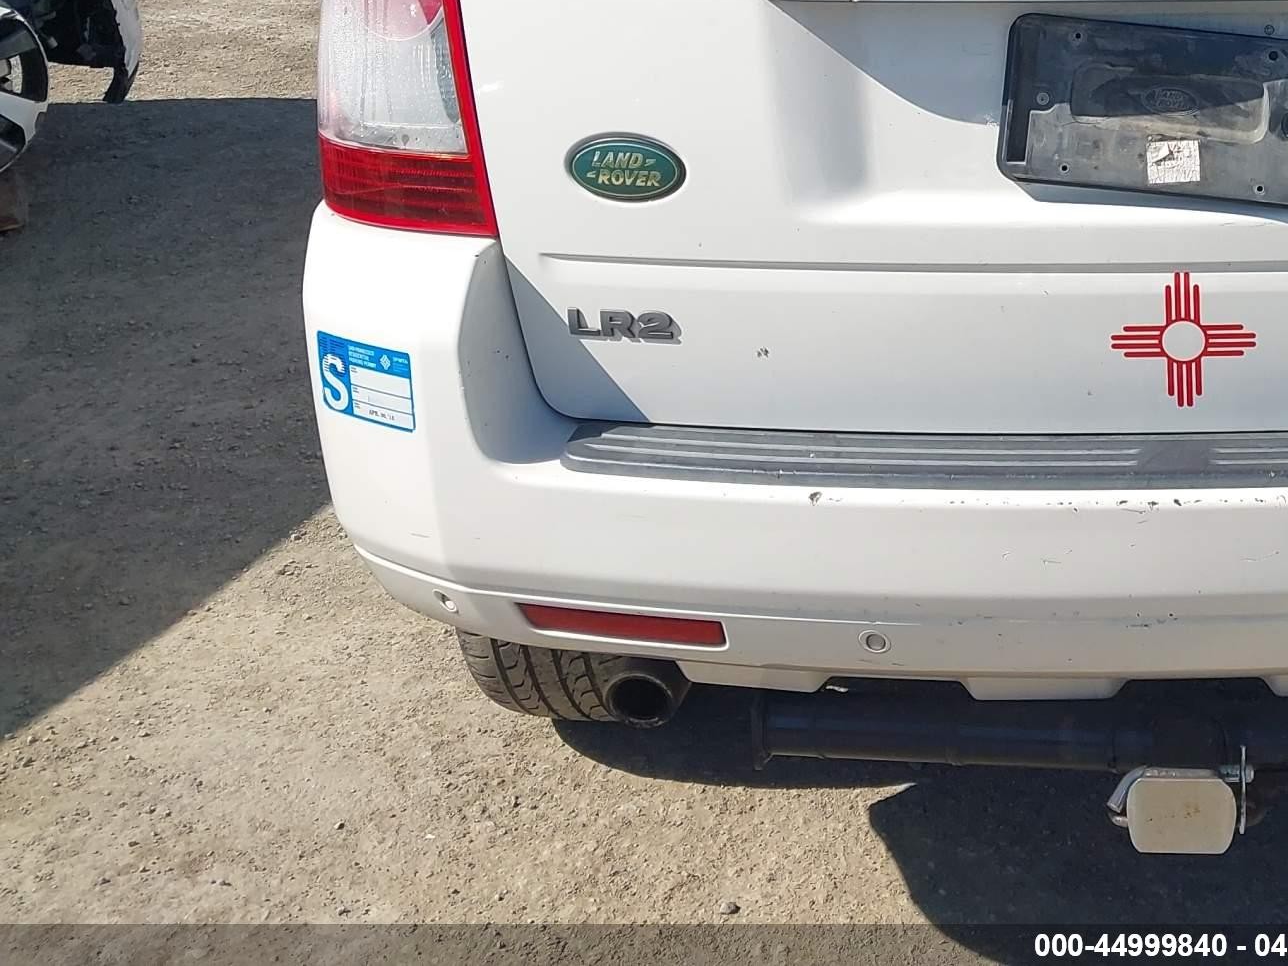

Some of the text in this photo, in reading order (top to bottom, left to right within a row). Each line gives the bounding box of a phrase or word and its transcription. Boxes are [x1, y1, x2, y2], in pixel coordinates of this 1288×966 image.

[592, 150, 643, 169] LAND
[598, 168, 661, 187] ROVER
[567, 307, 681, 343] LR2
[321, 353, 349, 411] S
